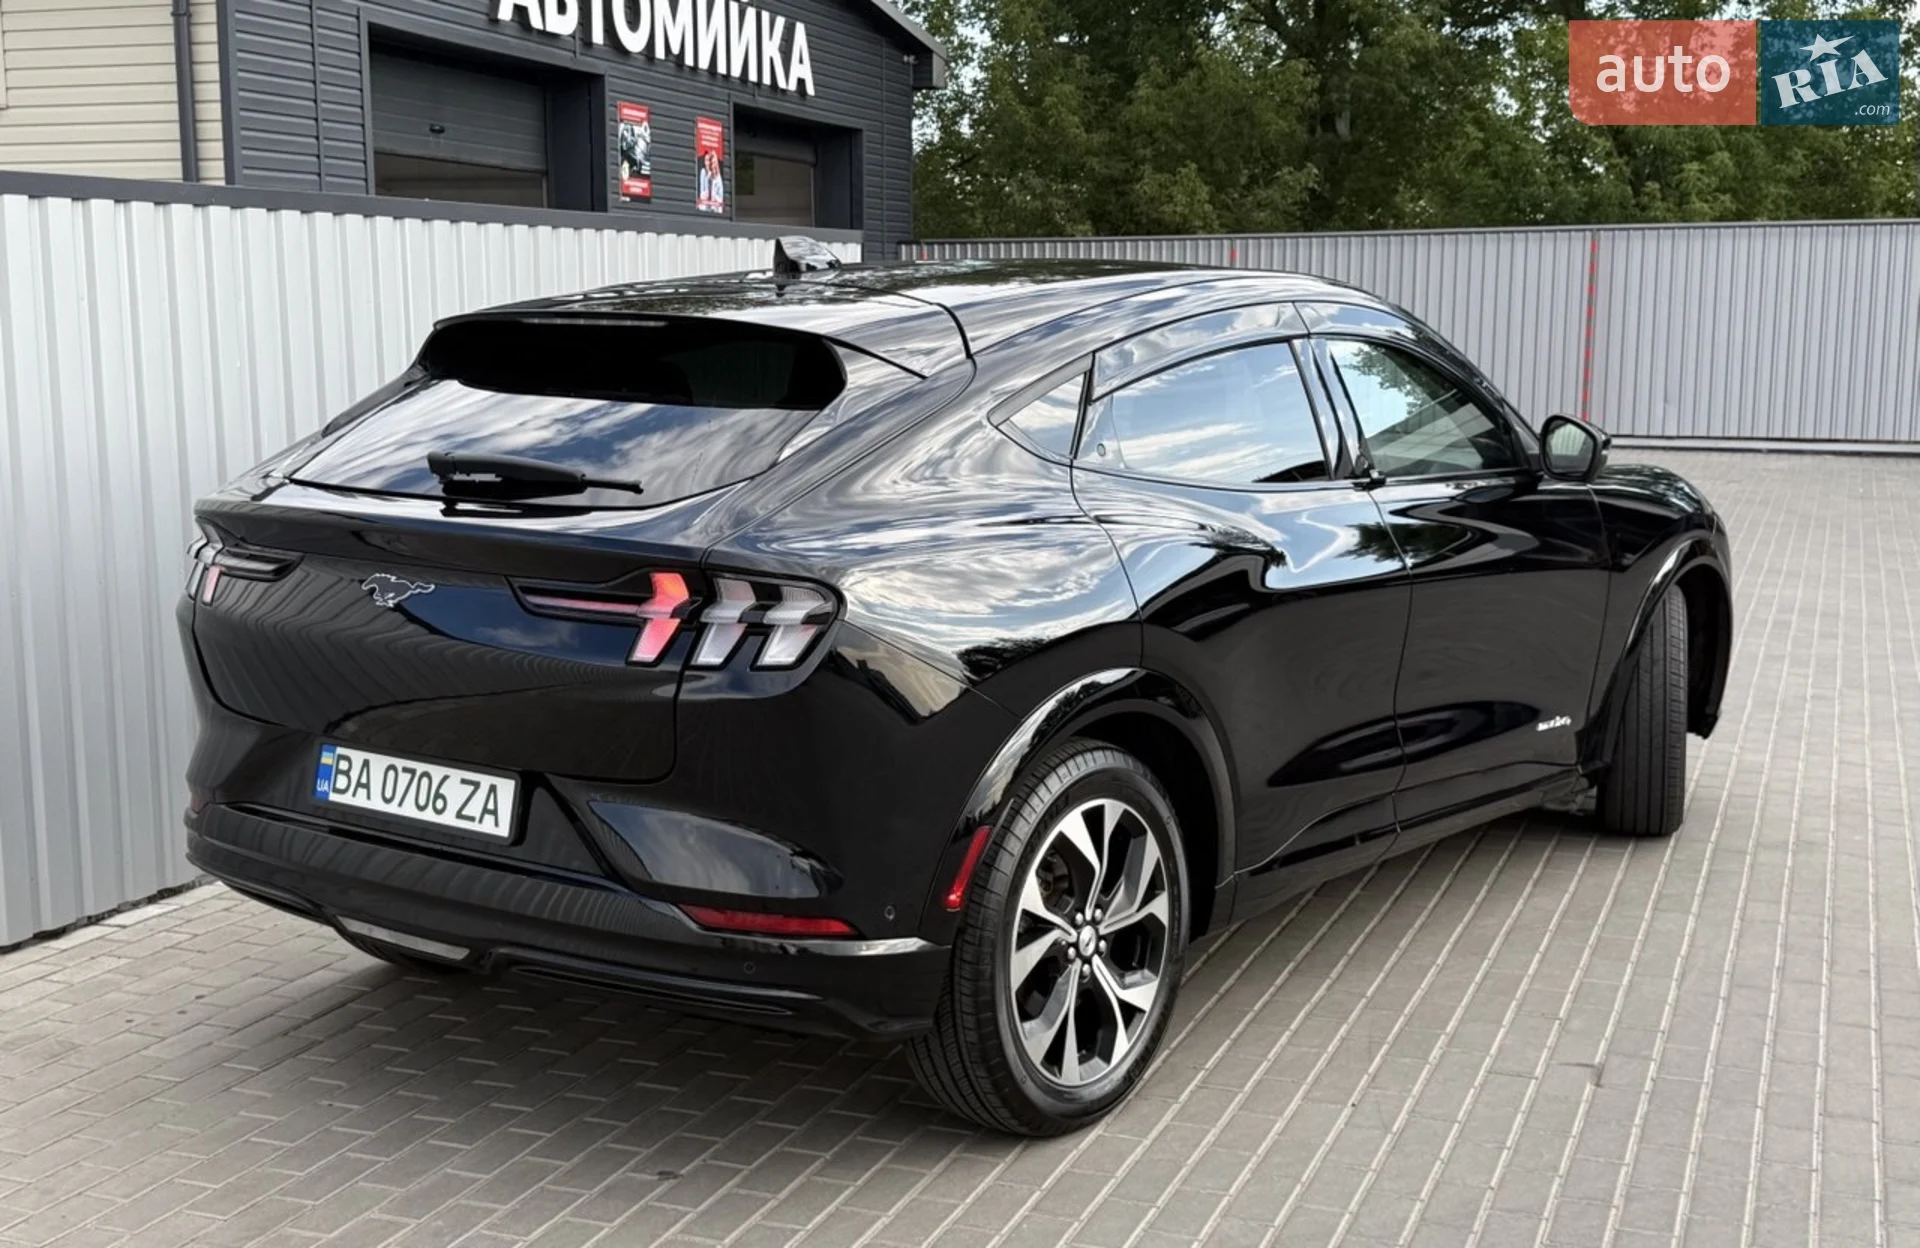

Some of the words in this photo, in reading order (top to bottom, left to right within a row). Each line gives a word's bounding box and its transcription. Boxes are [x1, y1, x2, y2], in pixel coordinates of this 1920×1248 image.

[316, 779, 329, 792] UA
[332, 754, 371, 800] BA
[381, 764, 450, 815] 0706
[455, 778, 499, 827] ZA
